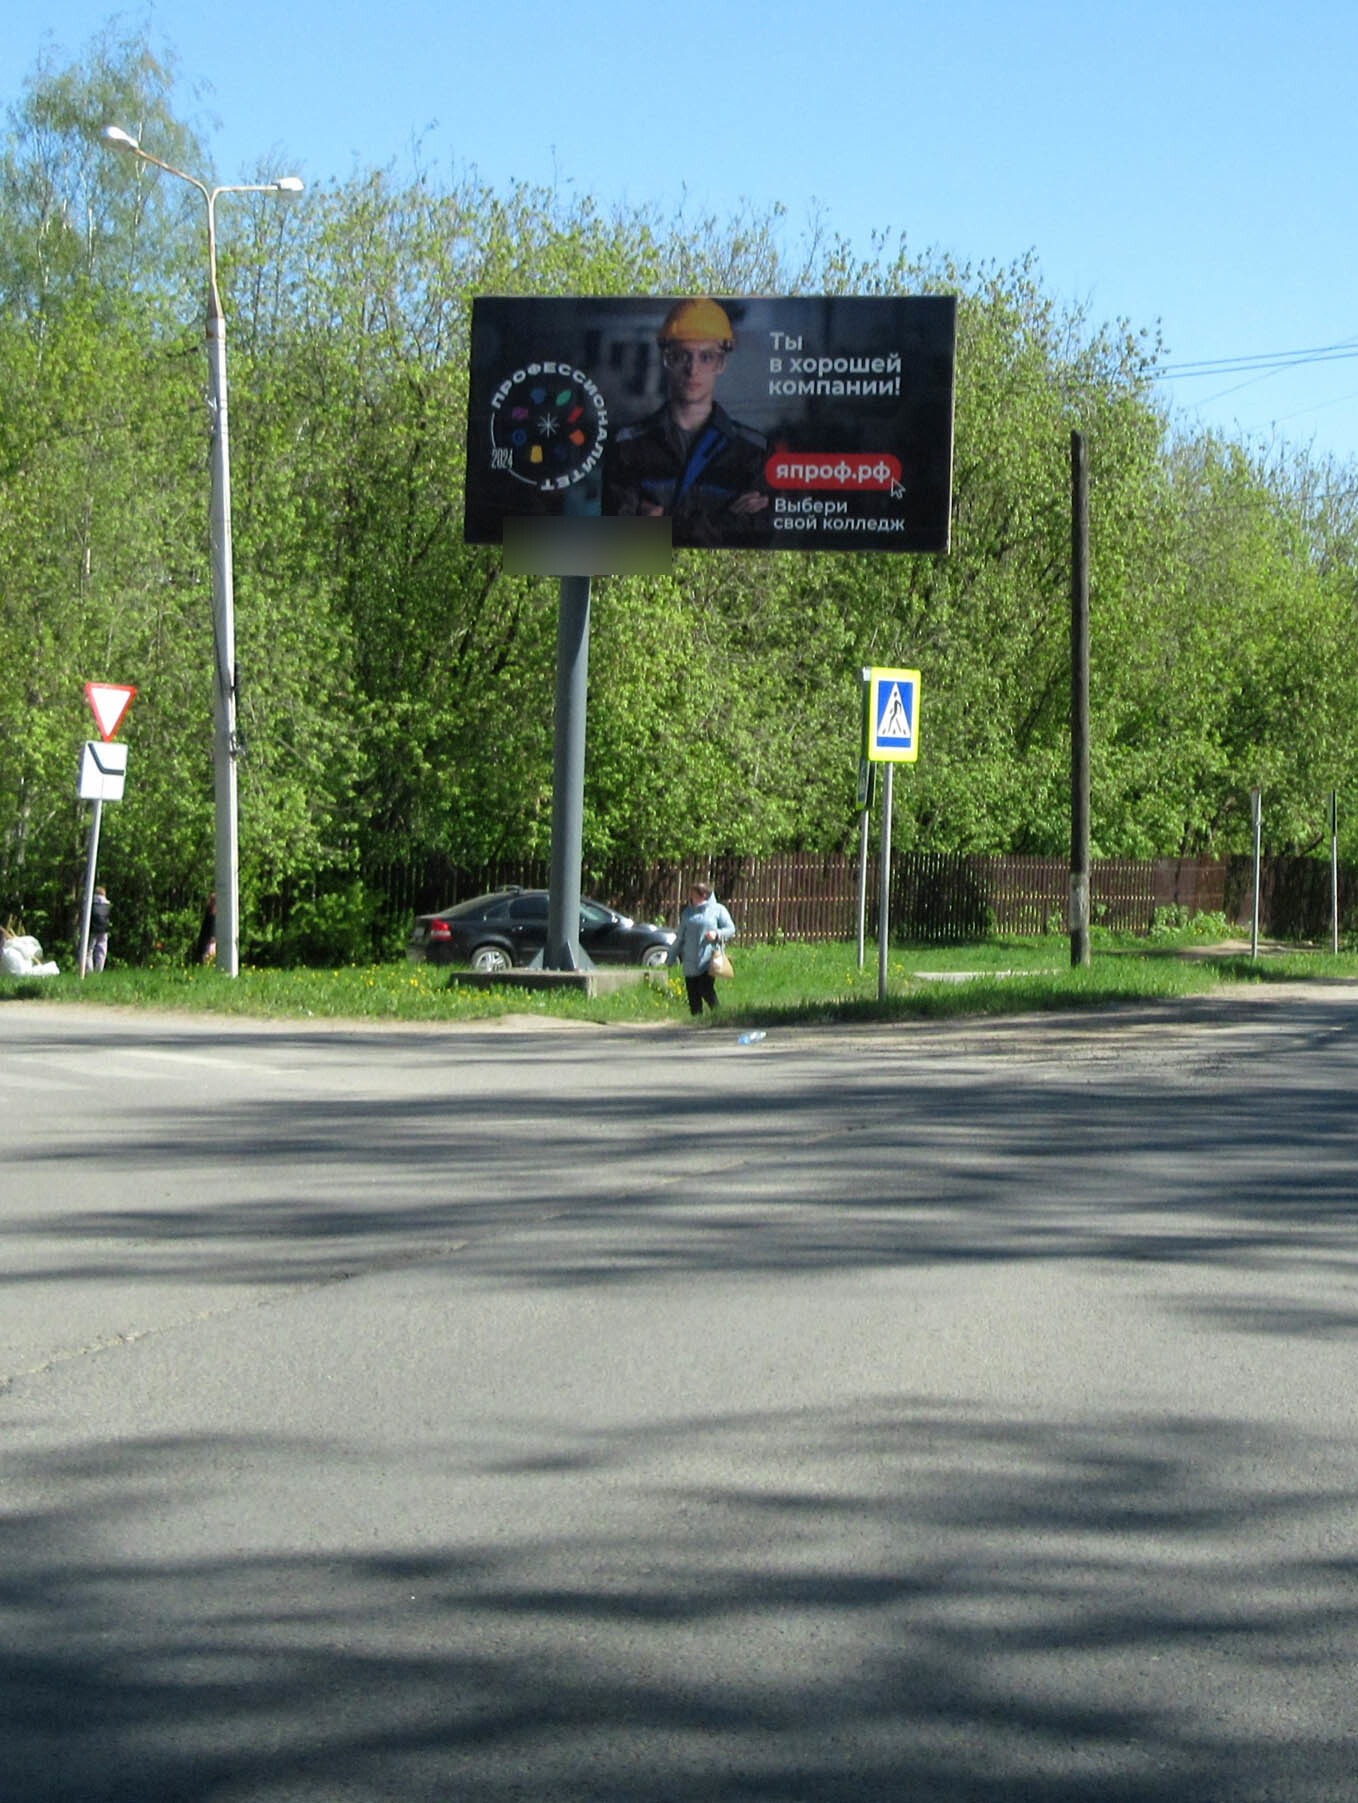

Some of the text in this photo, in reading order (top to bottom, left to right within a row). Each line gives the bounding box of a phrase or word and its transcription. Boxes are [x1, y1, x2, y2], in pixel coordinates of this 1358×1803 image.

[769, 331, 803, 351] Ты
[769, 352, 902, 377] в хорошей
[768, 377, 901, 396] компании!
[491, 361, 608, 491] ПРОФЕССИОНАЛИТЕТ
[491, 448, 513, 469] 2024
[776, 460, 891, 484] япроф.рф
[774, 498, 848, 516] Выбери
[773, 515, 905, 533] свой колледж
